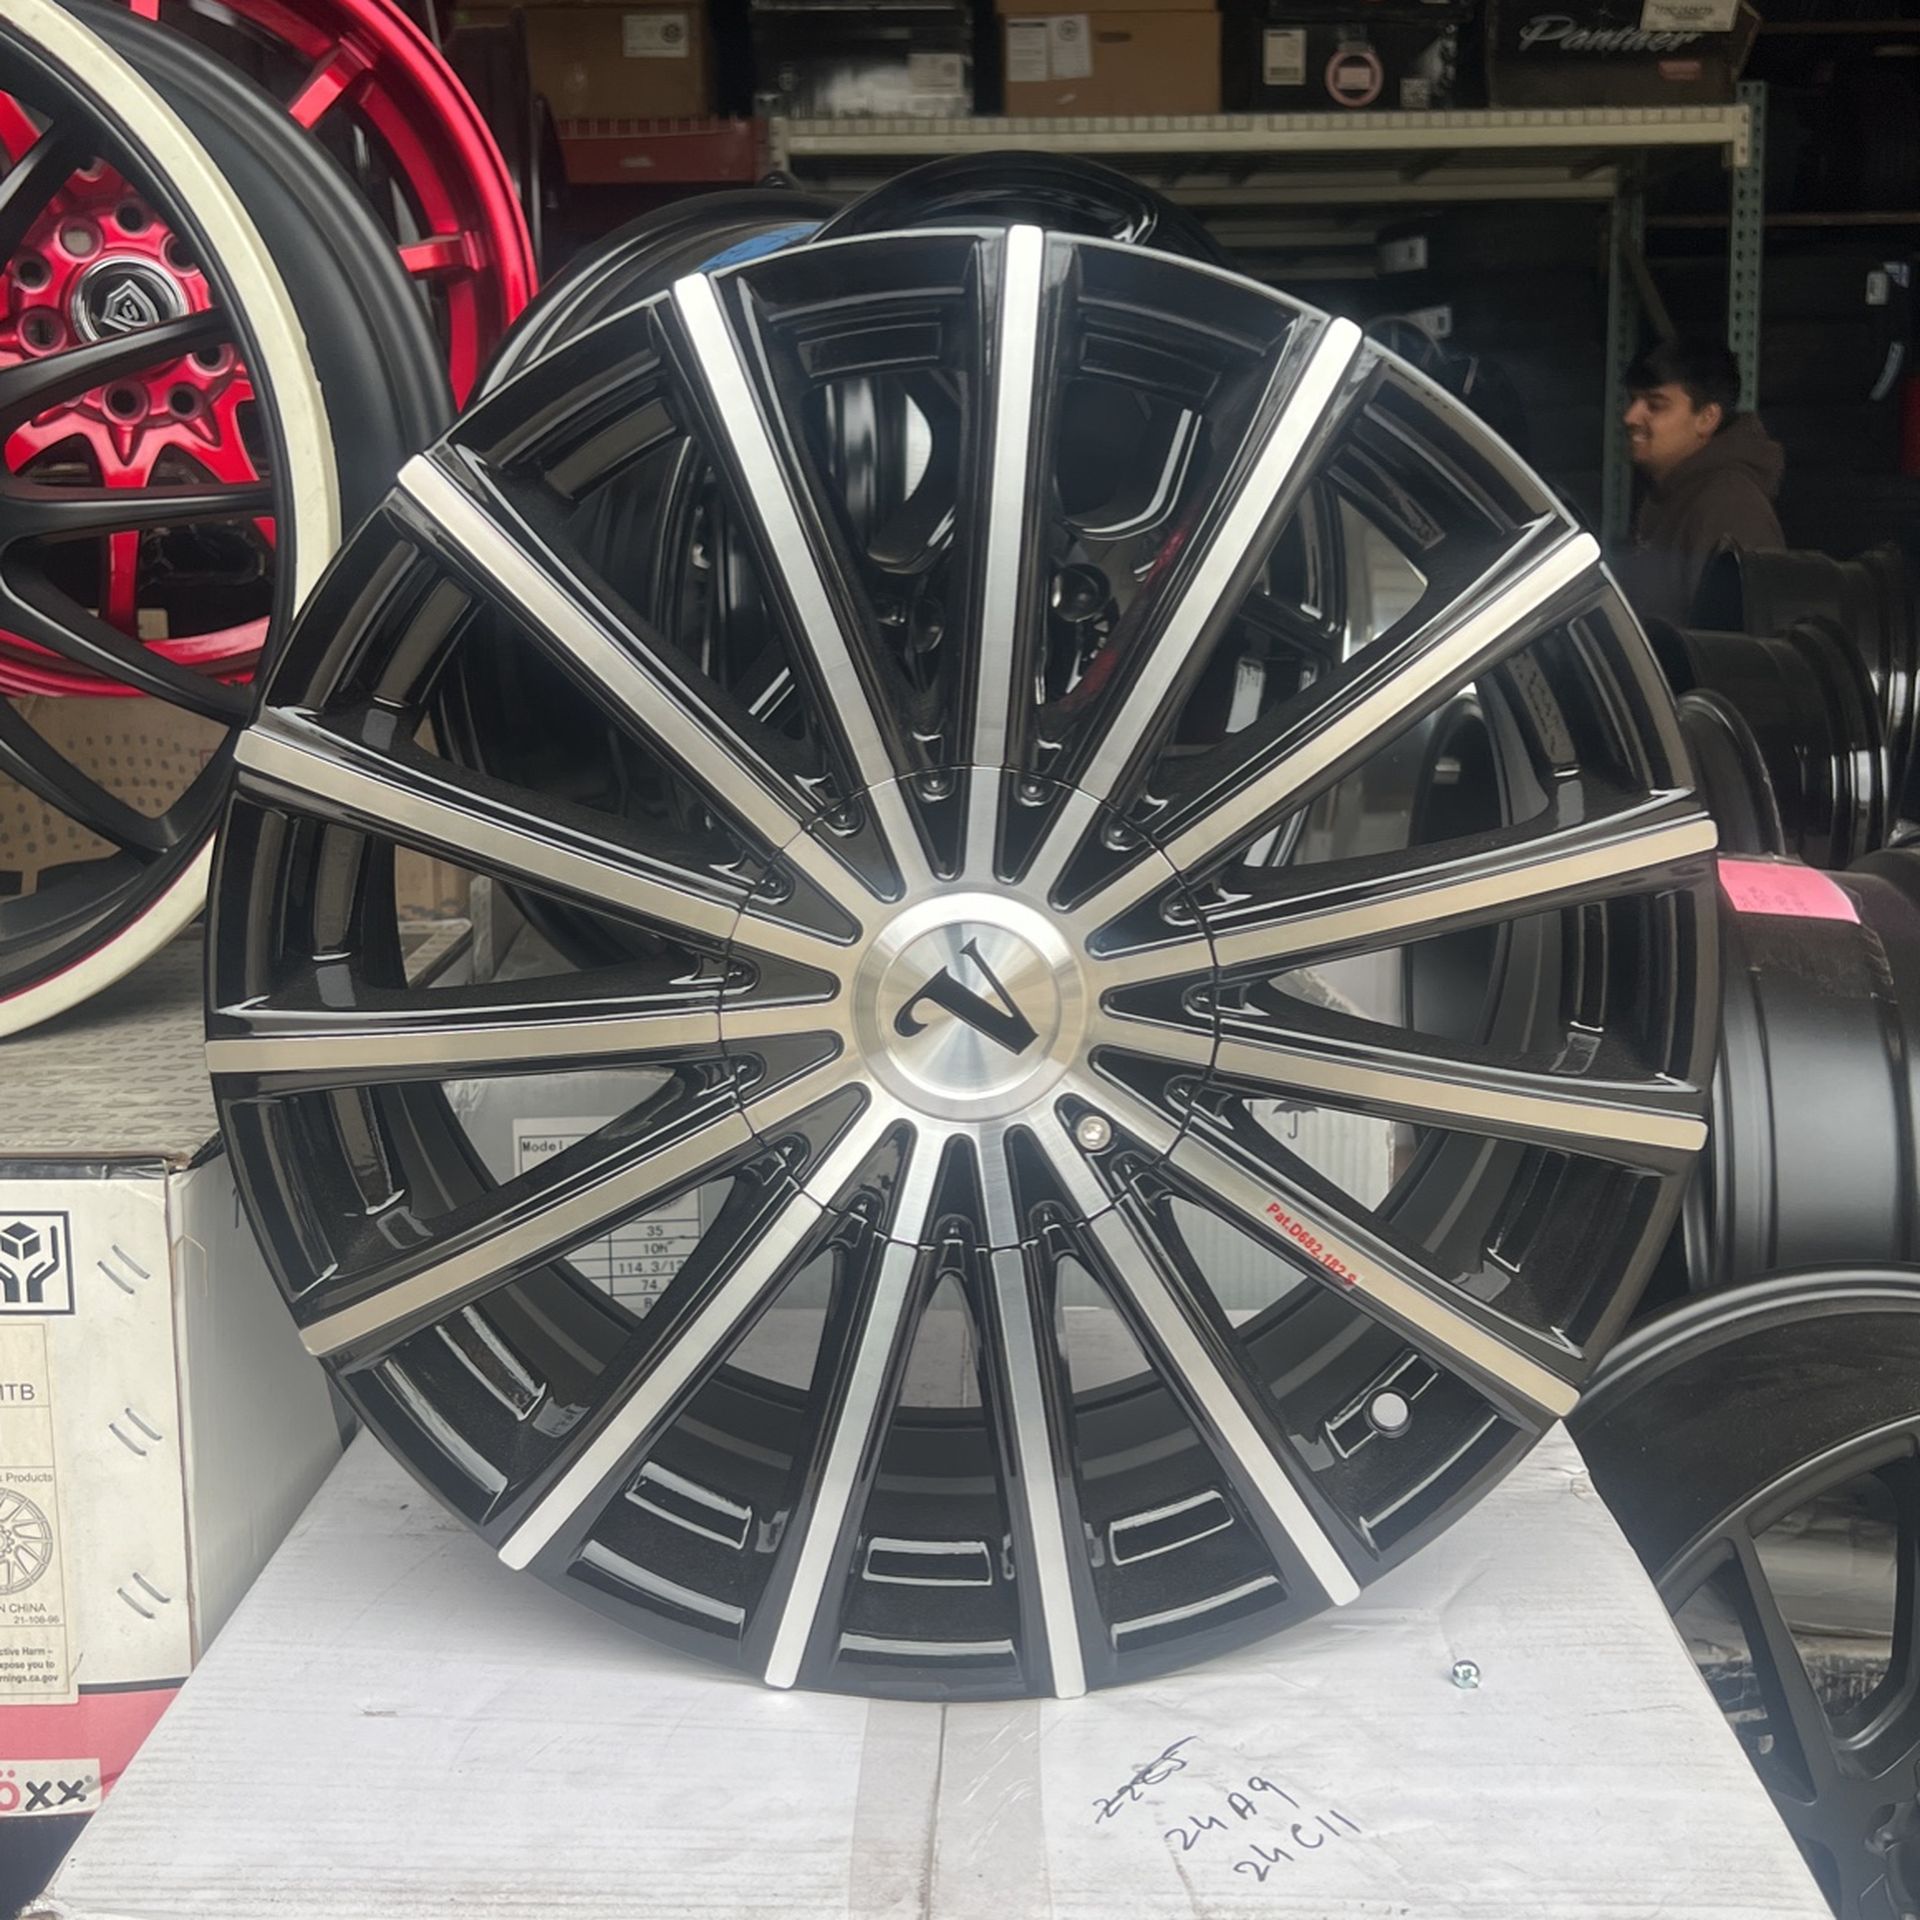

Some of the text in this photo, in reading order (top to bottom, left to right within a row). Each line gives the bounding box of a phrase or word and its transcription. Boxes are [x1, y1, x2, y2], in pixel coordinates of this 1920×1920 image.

[1518, 15, 1702, 51] Panther
[894, 937, 1039, 1056] V
[522, 1140, 564, 1153] Model
[647, 1225, 664, 1237] 35
[5, 1471, 54, 1482] Products
[9, 1603, 47, 1613] CHINA
[22, 1648, 46, 1656] Harm
[27, 1663, 44, 1671] you
[45, 1661, 55, 1669] to
